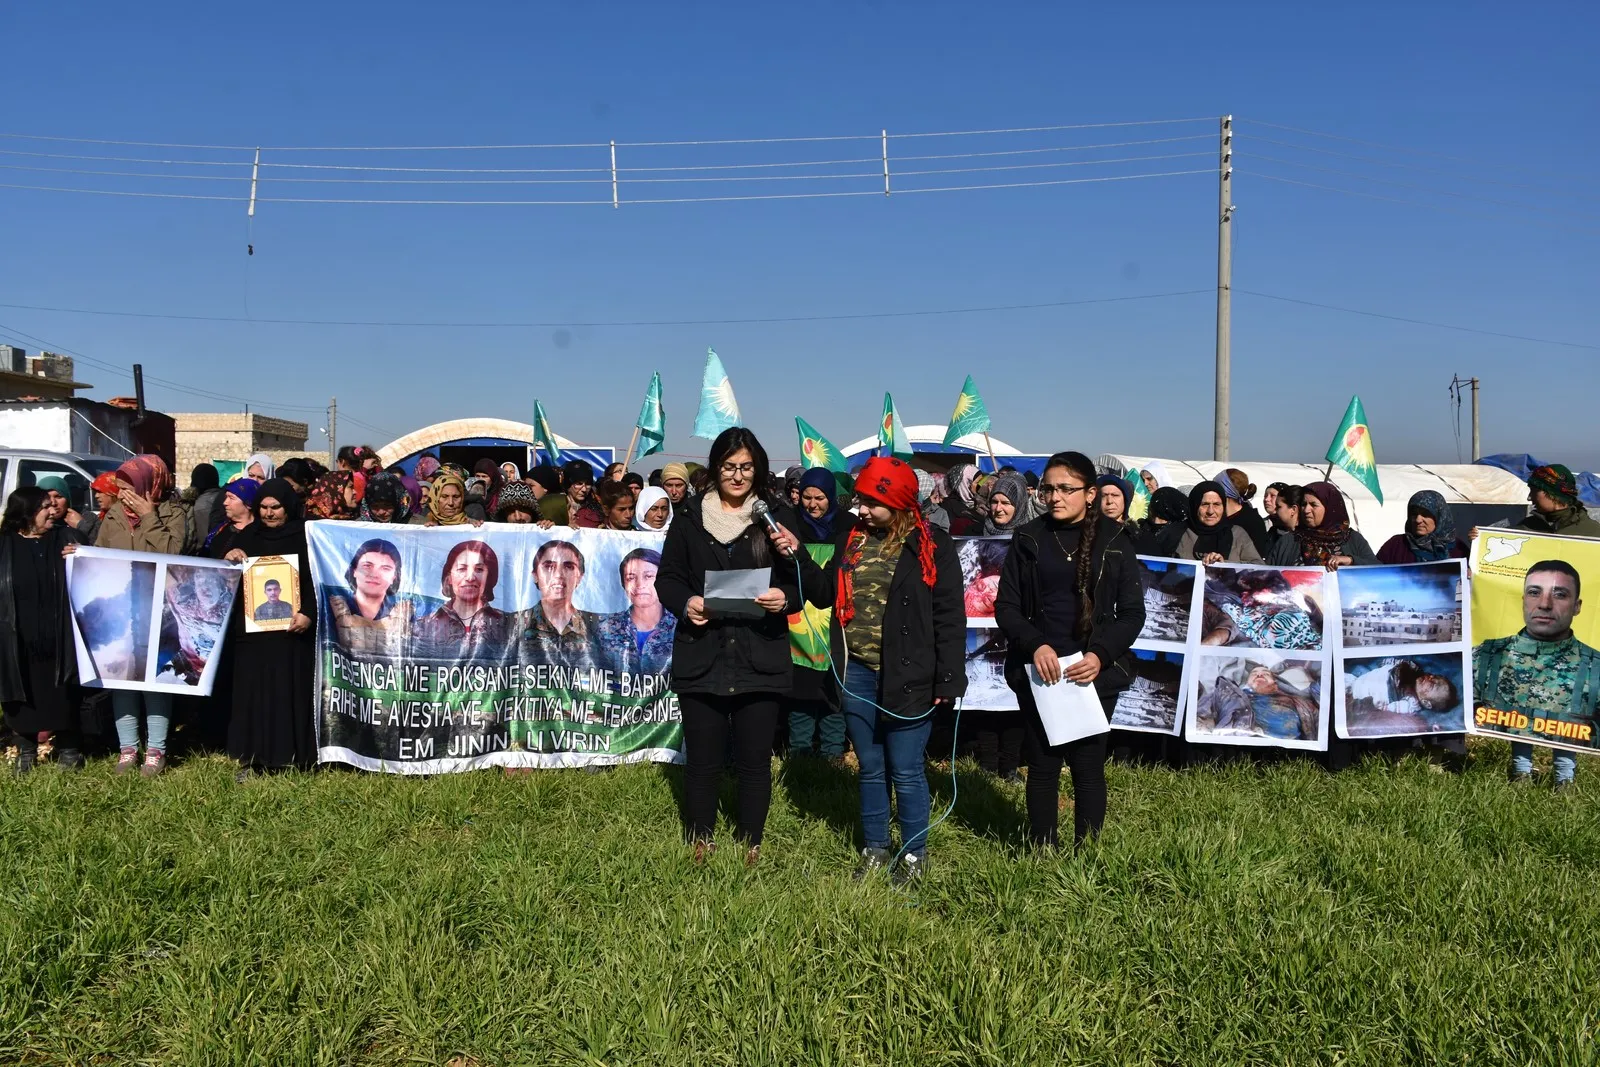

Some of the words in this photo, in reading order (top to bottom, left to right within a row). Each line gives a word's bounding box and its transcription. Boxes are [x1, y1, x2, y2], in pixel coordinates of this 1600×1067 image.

[405, 666, 429, 692] ME
[590, 668, 614, 694] ME
[620, 671, 673, 698] BARÎN
[330, 687, 357, 719] RIHE
[360, 698, 382, 725] ME
[388, 701, 453, 728] AVESTA
[460, 700, 486, 729] YE,
[570, 699, 596, 725] ME
[1475, 706, 1529, 729] ŞEHÎD
[1532, 717, 1592, 741] DEMIR
[399, 737, 434, 759] EM
[447, 731, 508, 756] JININ
[527, 731, 543, 751] LI
[550, 730, 610, 752] VIRIN
